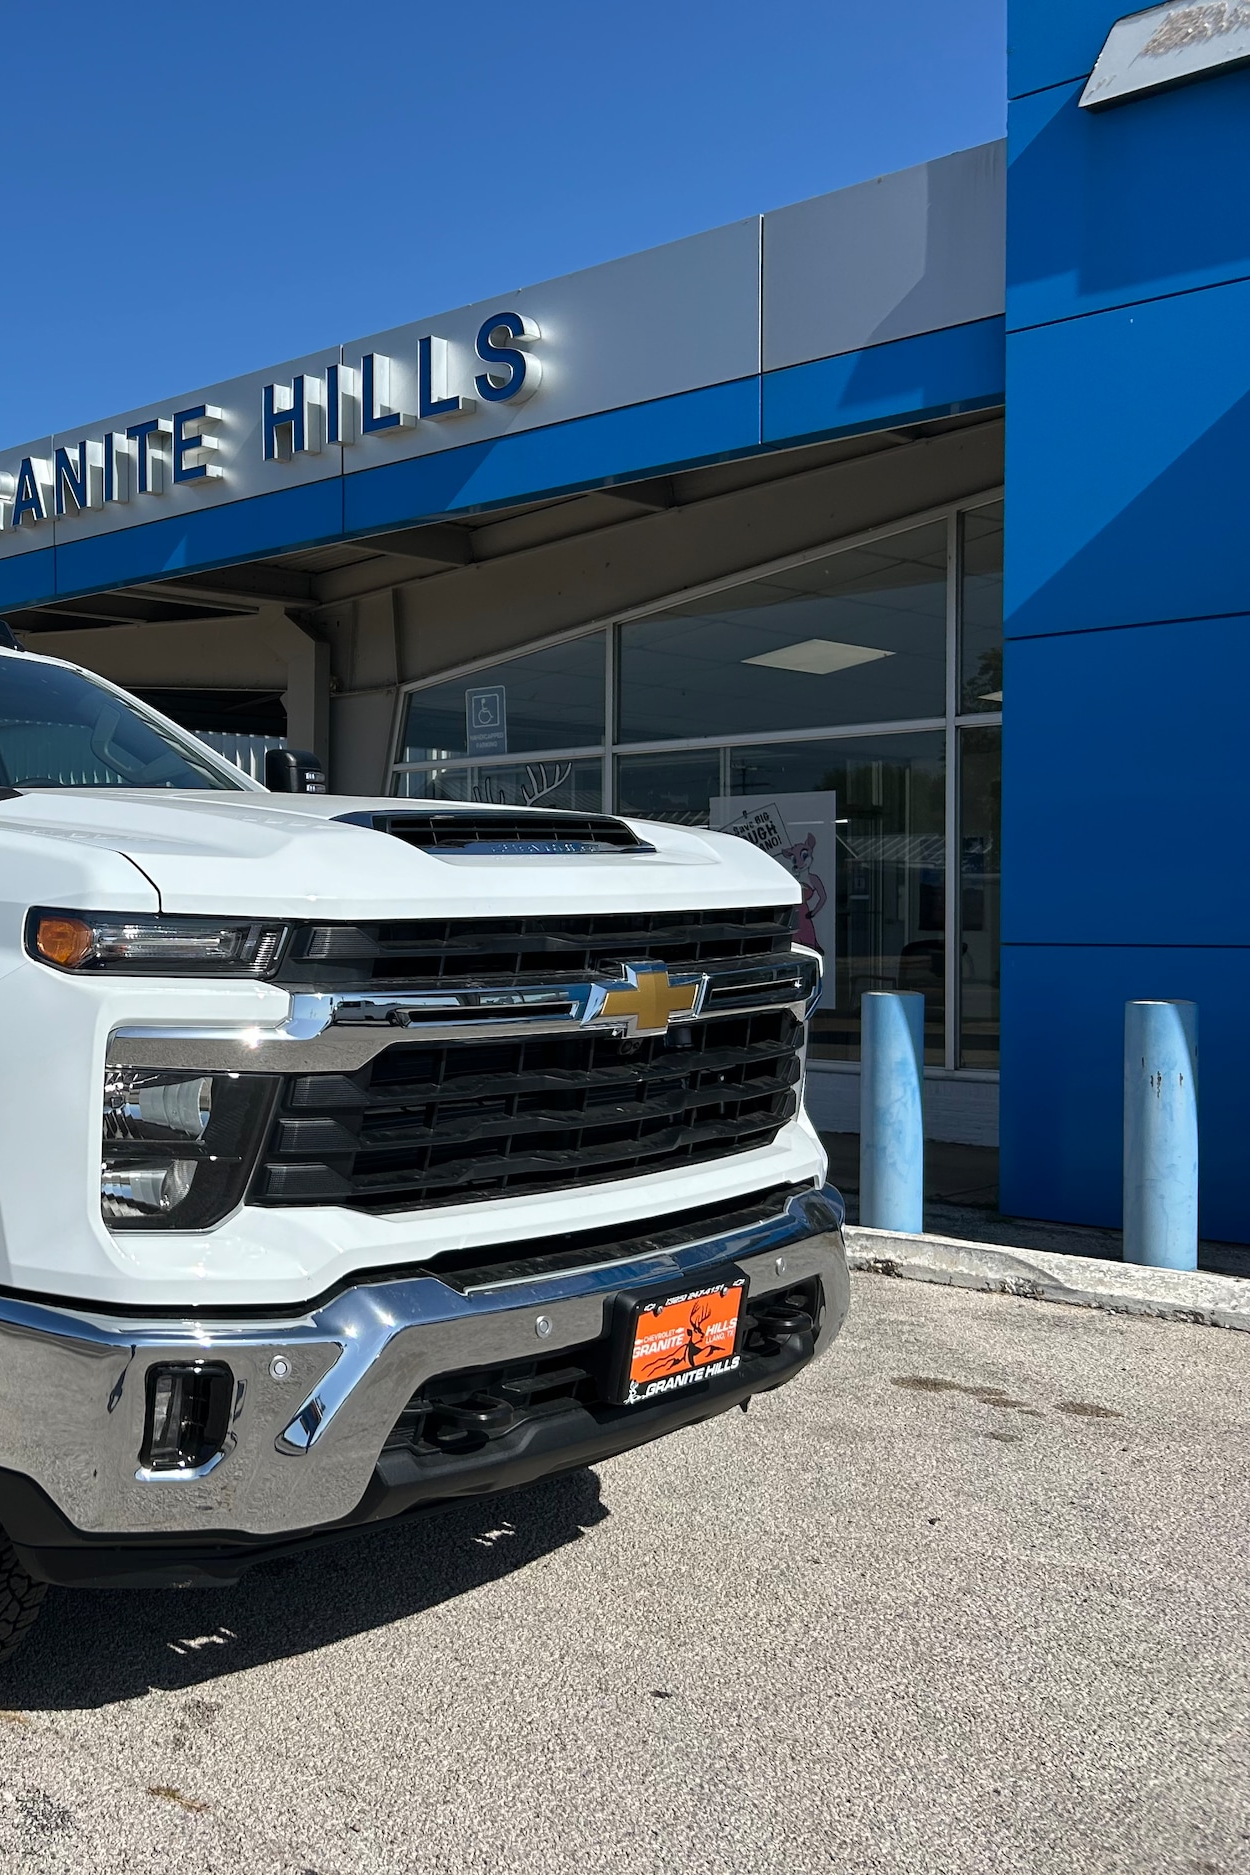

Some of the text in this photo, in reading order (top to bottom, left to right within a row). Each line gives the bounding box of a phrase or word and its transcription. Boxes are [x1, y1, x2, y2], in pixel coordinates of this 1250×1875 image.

[261, 312, 542, 462] HILLS
[733, 811, 770, 836] Save BIG
[643, 1328, 676, 1344] CHEVROLET
[705, 1317, 738, 1336] HILLS
[632, 1334, 685, 1359] GRANITE
[646, 1355, 741, 1398] GRANITE HILLS
